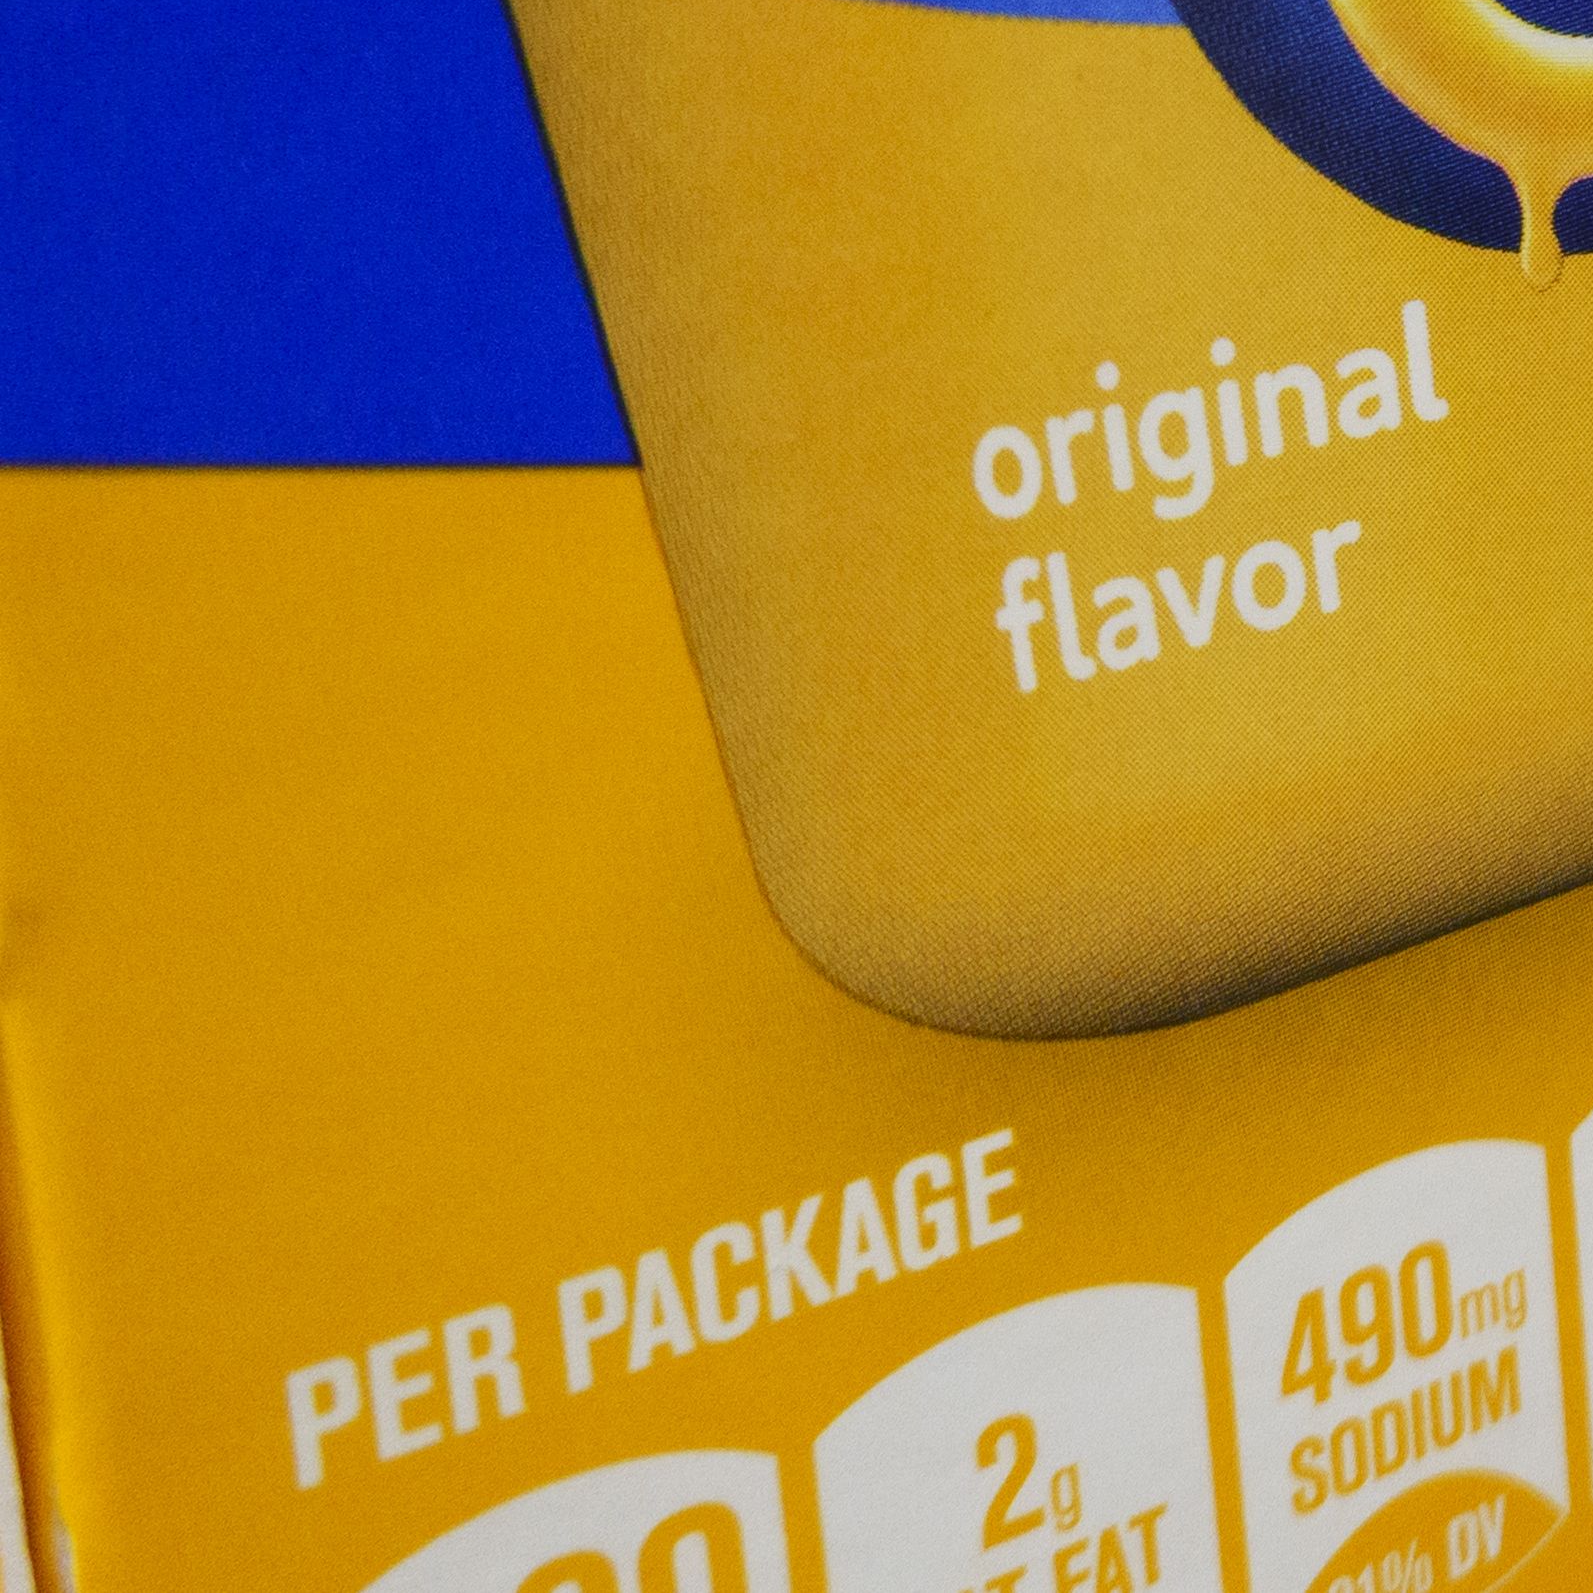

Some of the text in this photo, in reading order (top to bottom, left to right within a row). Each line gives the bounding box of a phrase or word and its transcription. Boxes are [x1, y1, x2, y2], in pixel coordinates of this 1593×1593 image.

[973, 299, 1449, 521] original
[996, 520, 1362, 693] flavor
[286, 1127, 1024, 1492] PER PACKAGE
[1279, 1239, 1528, 1407] 490mg
[975, 1411, 1082, 1553] 2g
[1290, 1346, 1522, 1517] SODIUM
[1053, 1501, 1169, 1593] FAT
[1446, 1493, 1507, 1584] DV
